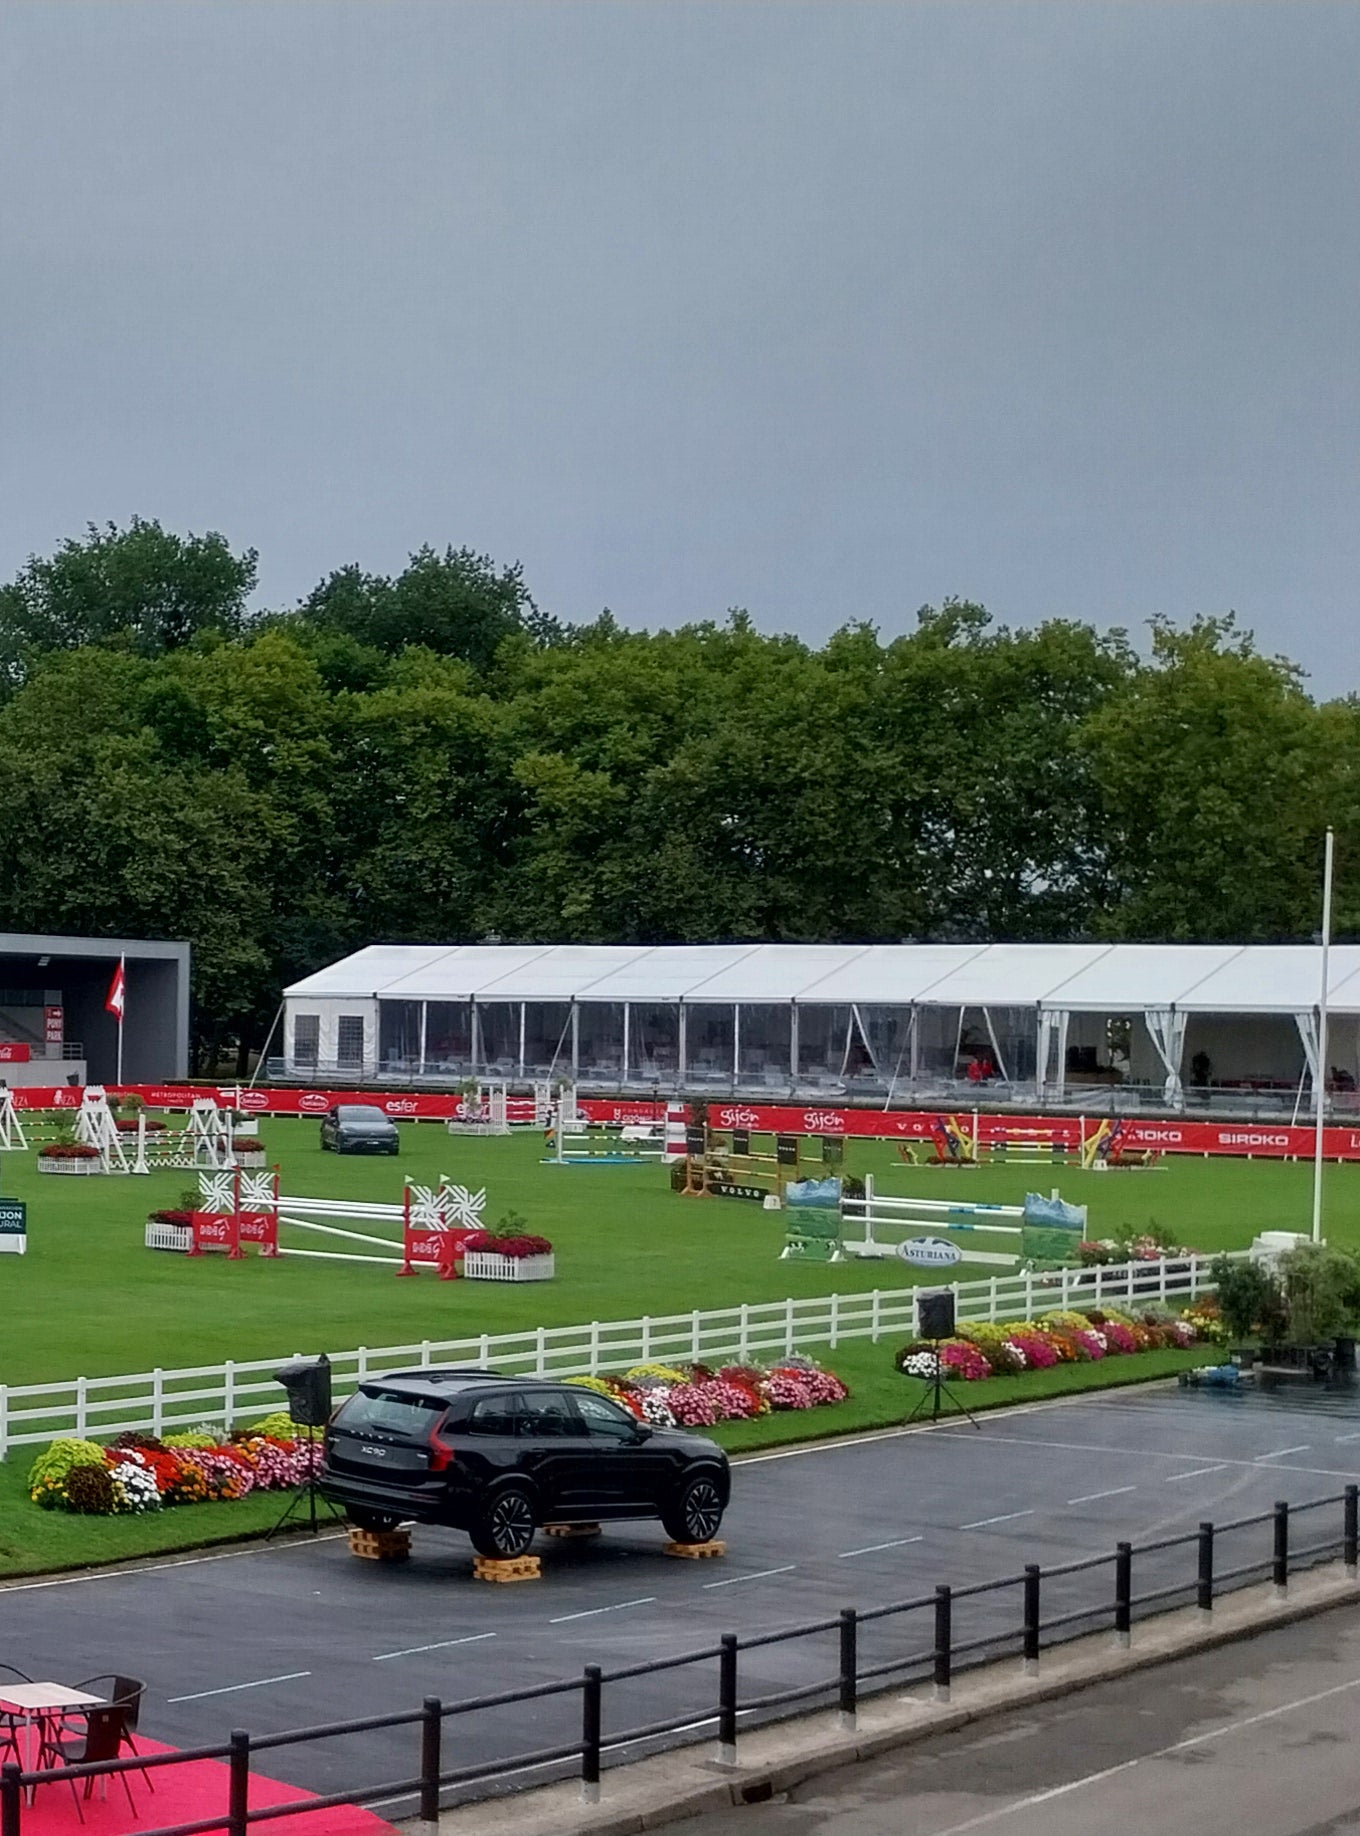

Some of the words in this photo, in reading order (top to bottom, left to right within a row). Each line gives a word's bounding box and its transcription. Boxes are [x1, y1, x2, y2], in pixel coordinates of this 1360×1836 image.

[386, 1098, 419, 1113] esfer
[1218, 1133, 1289, 1146] SIROKO
[721, 1186, 760, 1197] VOLVO
[902, 1245, 956, 1260] ASTURIANA
[361, 1445, 387, 1456] XC90
